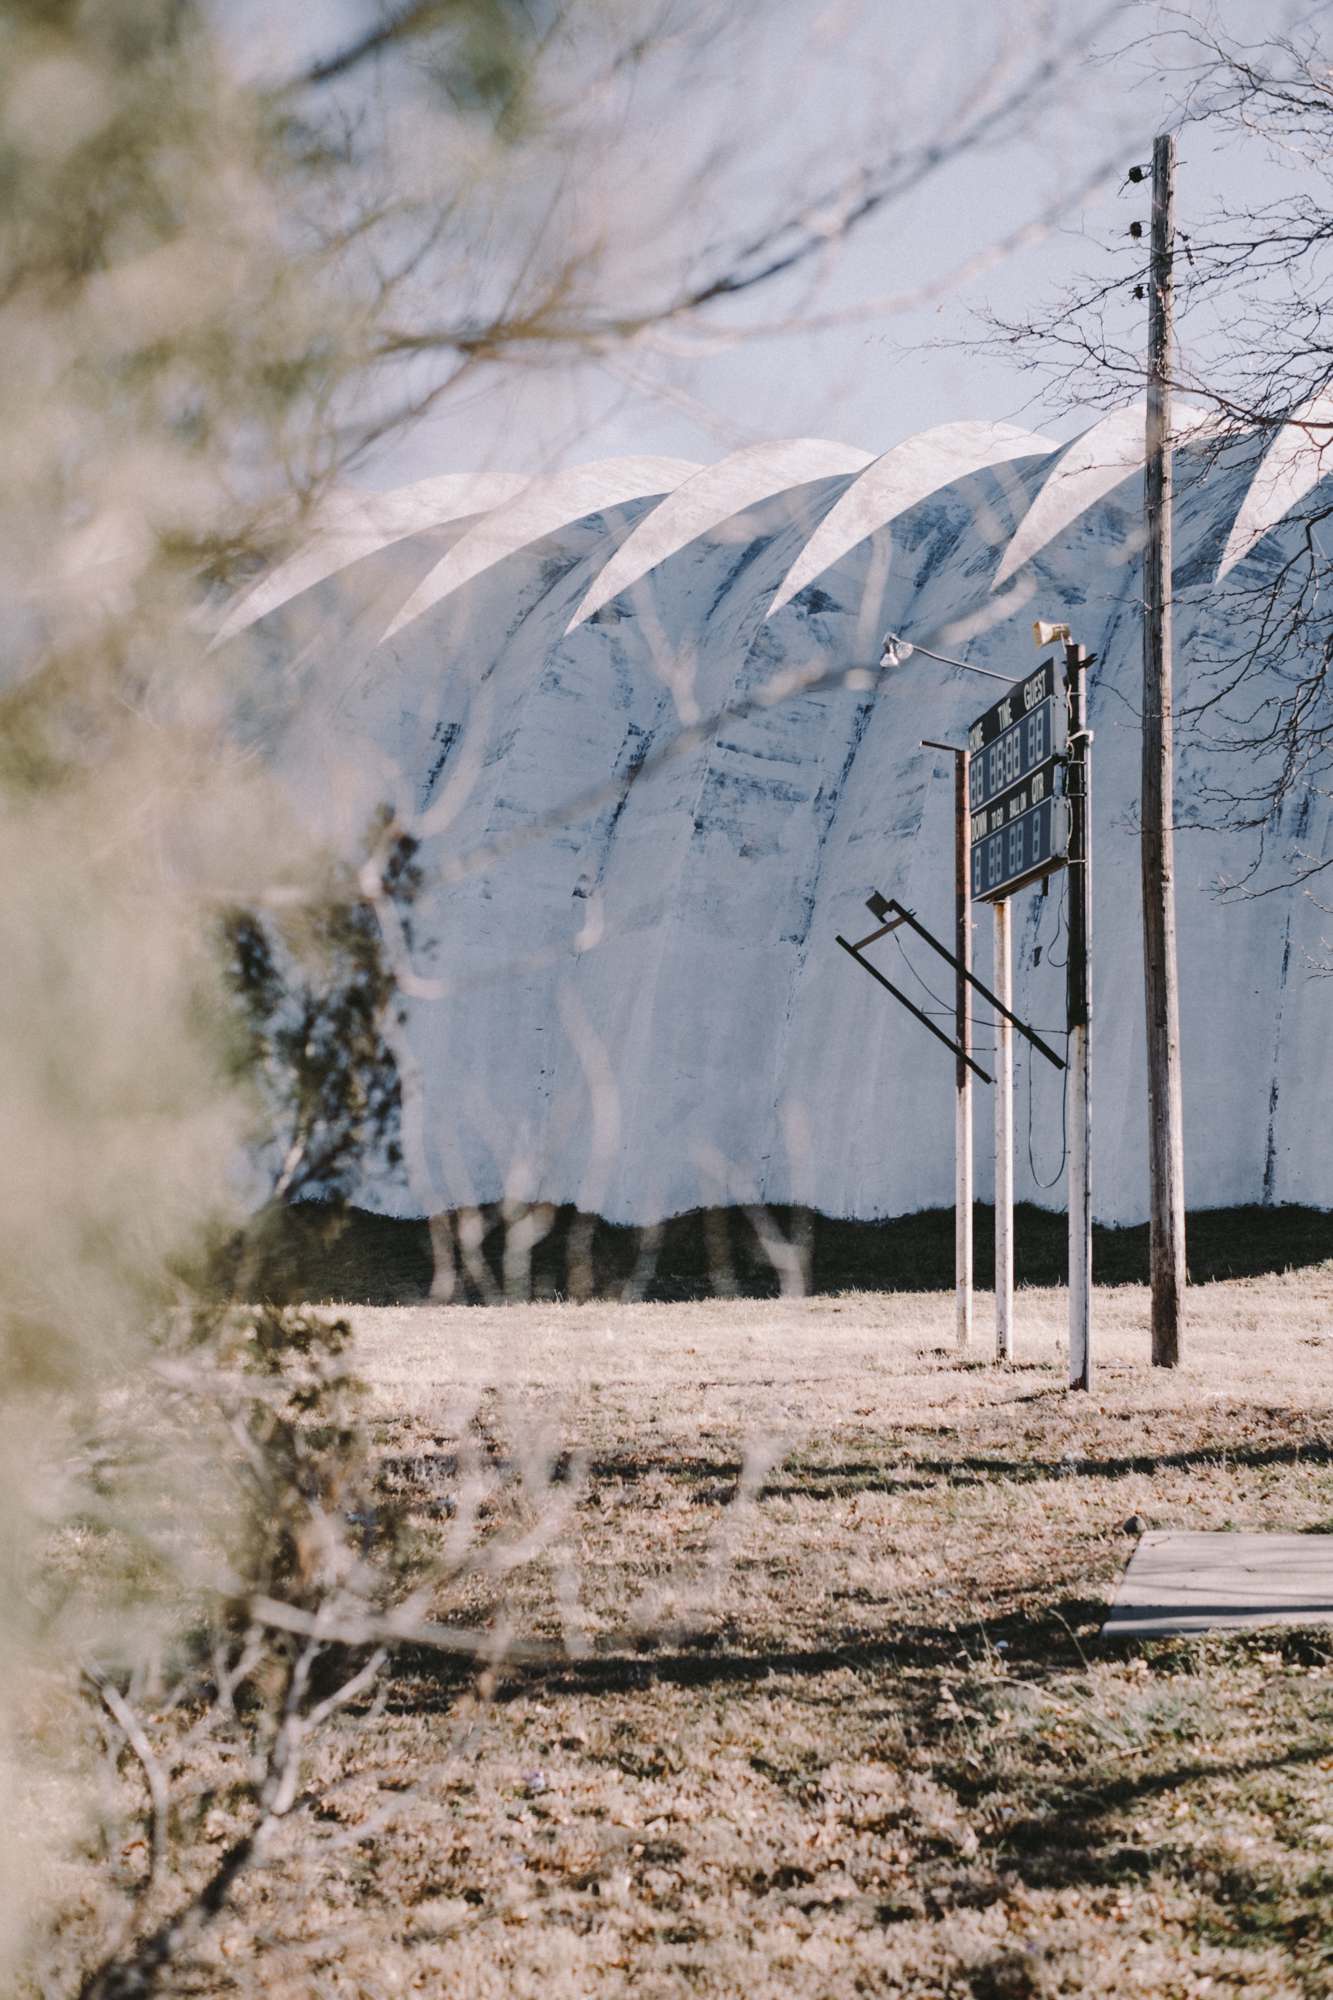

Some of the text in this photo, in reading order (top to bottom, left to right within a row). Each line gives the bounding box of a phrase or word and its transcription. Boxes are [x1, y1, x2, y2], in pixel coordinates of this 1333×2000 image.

[1023, 669, 1046, 711] GUEST
[1031, 772, 1044, 804] QTR
[971, 810, 988, 843] DOWN
